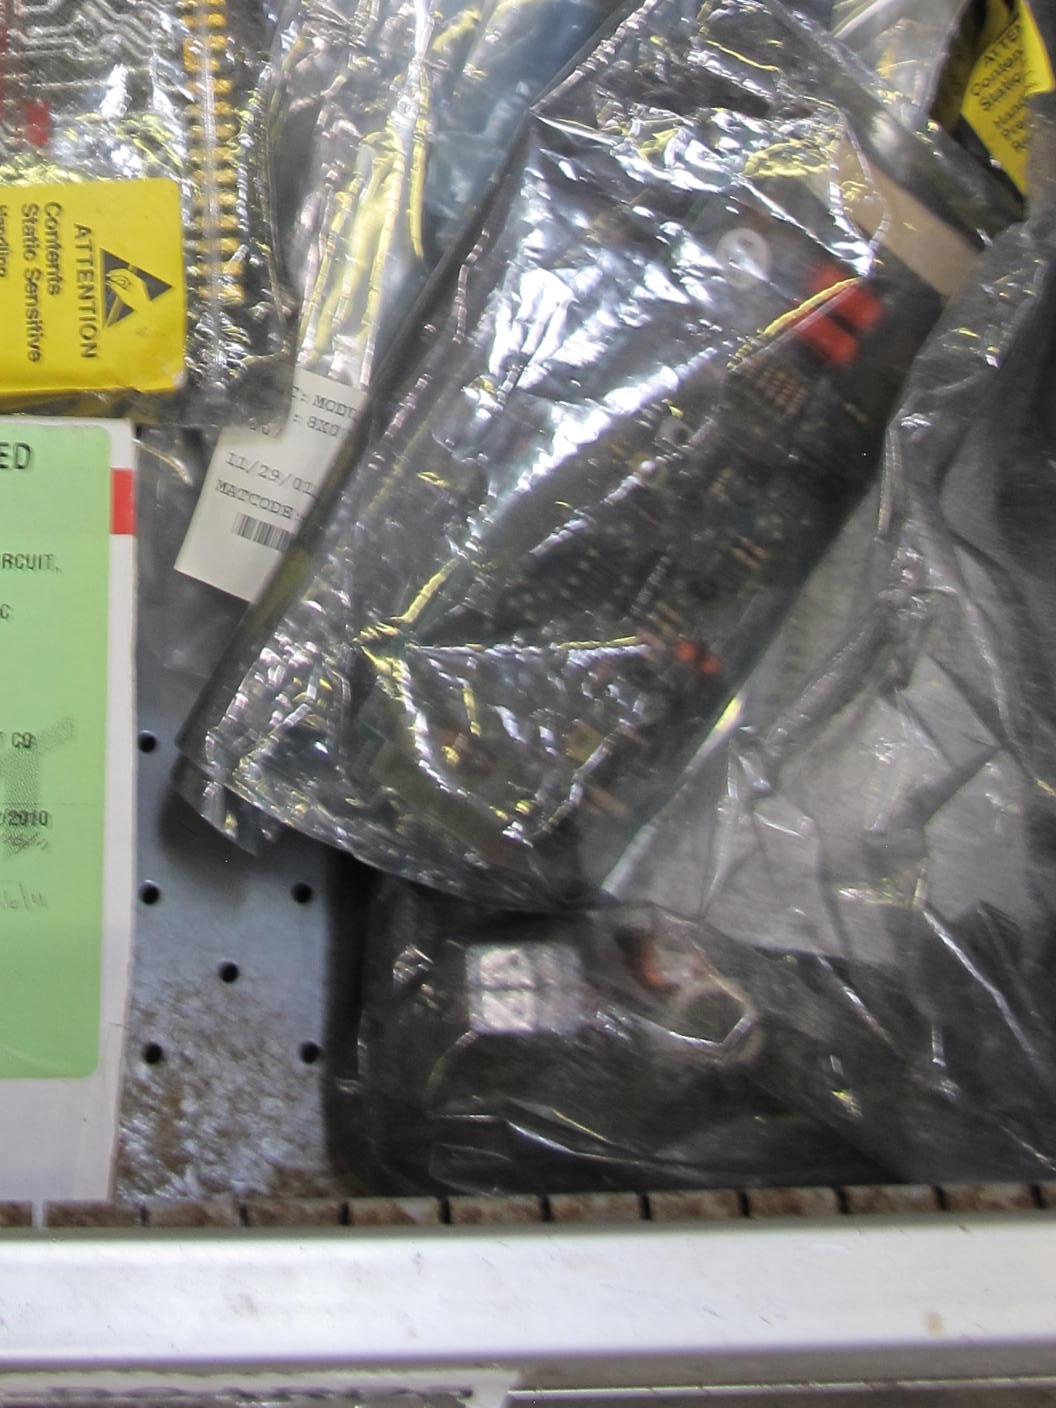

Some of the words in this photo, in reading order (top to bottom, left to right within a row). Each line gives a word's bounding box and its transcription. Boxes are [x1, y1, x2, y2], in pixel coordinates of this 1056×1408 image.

[21, 203, 41, 262] Static
[43, 201, 63, 296] Contents
[23, 268, 43, 364] Sensitive
[73, 222, 99, 360] ATTENTION
